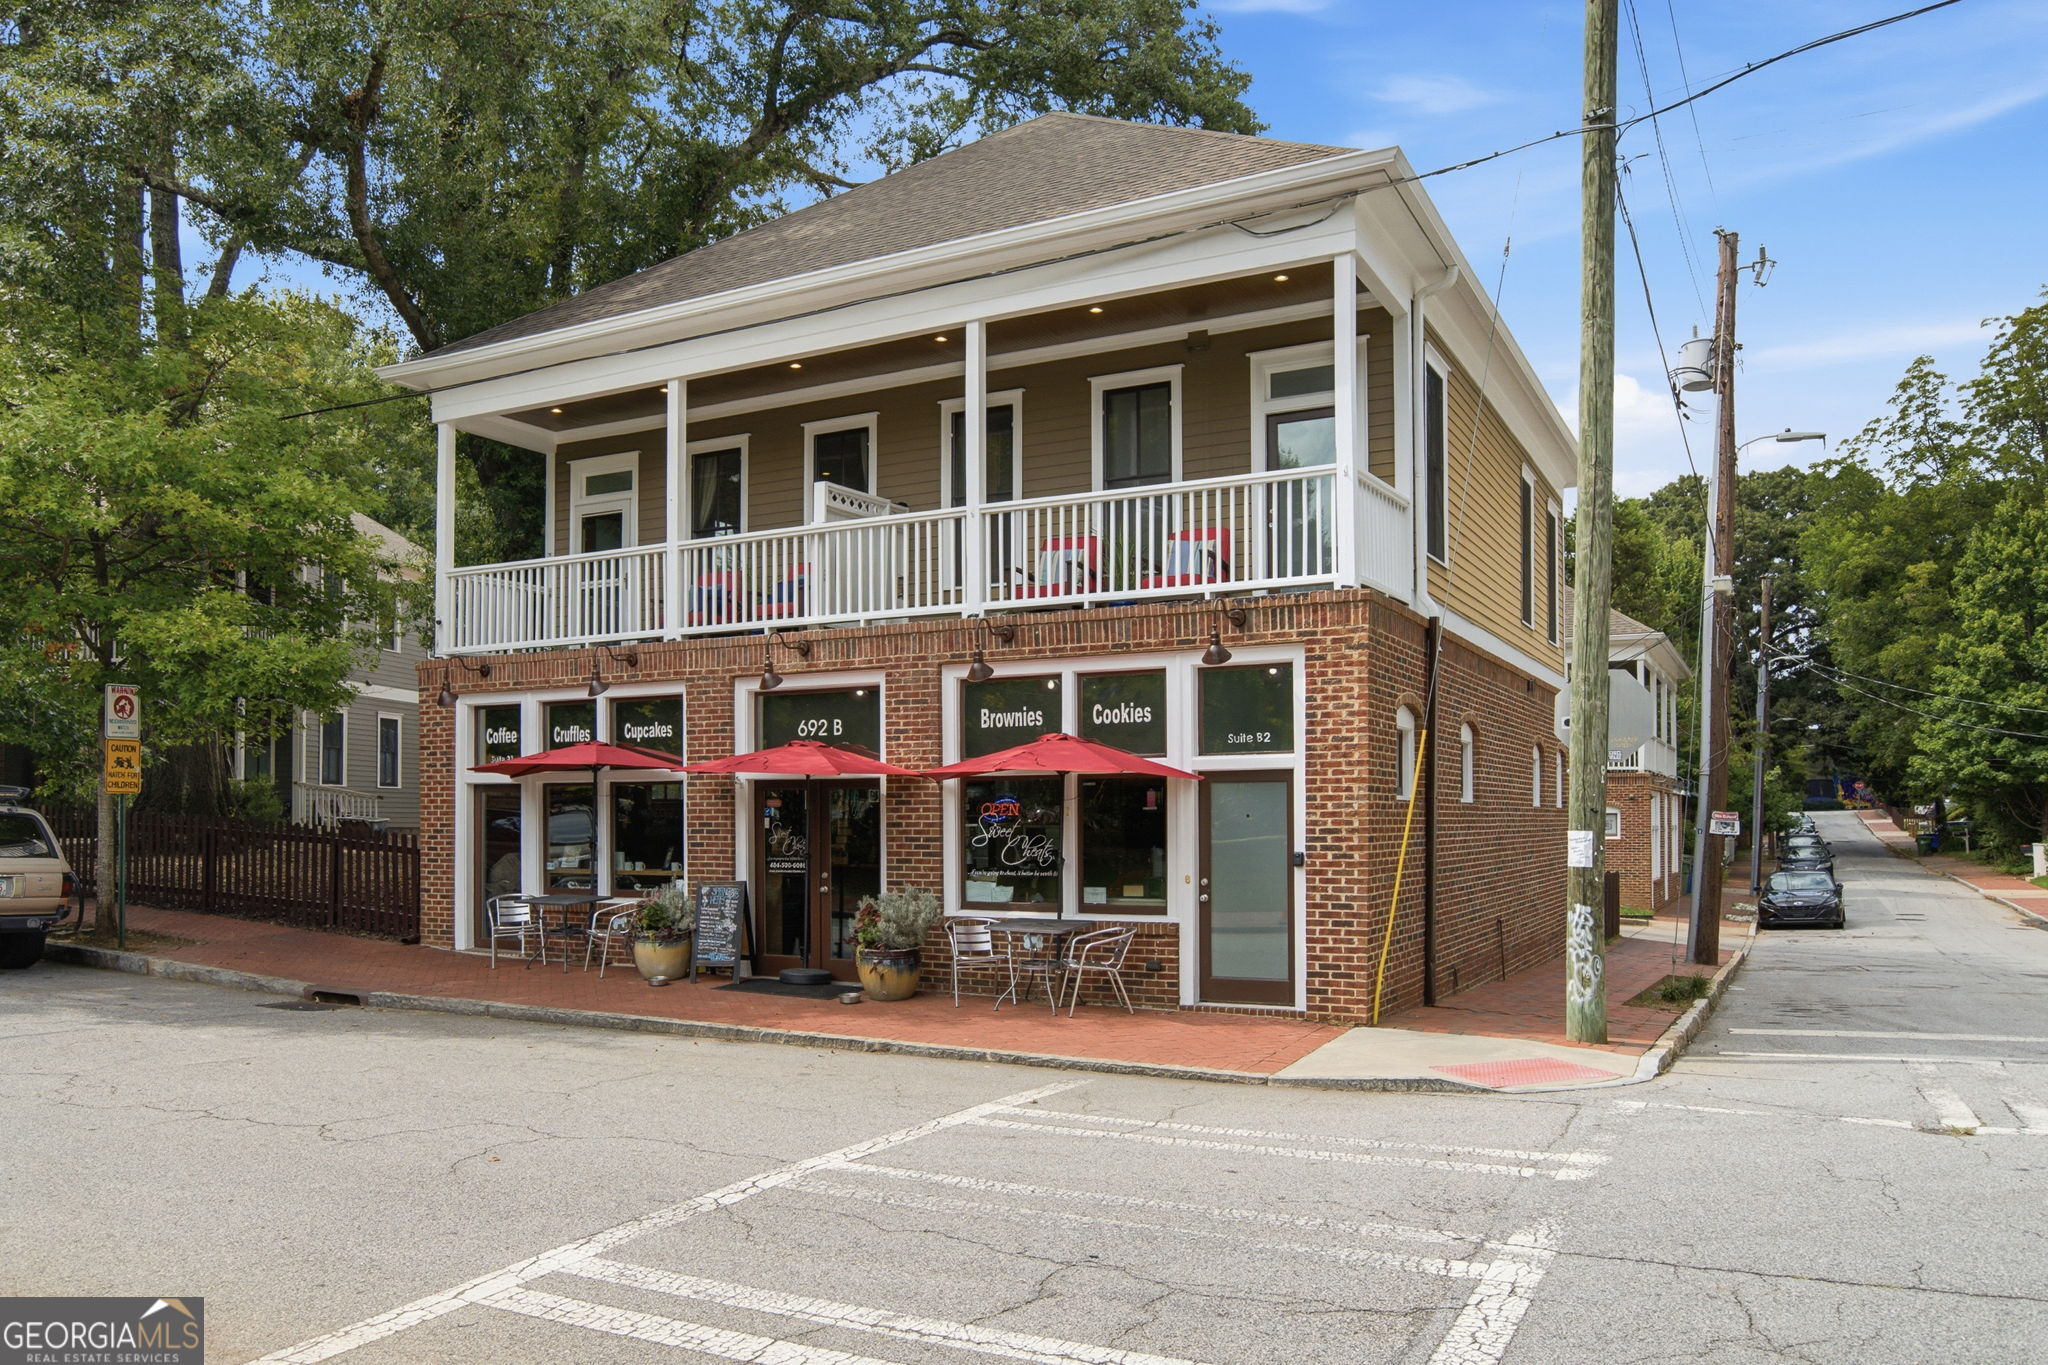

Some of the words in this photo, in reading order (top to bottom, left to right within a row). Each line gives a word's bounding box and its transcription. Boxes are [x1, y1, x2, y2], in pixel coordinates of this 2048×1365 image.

[980, 706, 1043, 729] Brownies
[1092, 703, 1152, 725] Cookies
[486, 727, 518, 744] Coffee
[553, 725, 591, 743] Cruffles
[624, 721, 673, 742] Cupcakes
[797, 719, 828, 737] 692
[833, 718, 843, 736] B
[1227, 732, 1254, 744] Suite
[110, 744, 137, 753] CAUTION
[108, 781, 138, 789] CHILDREN
[981, 803, 1020, 816] OPEN
[972, 813, 1022, 848] Sweet
[1001, 835, 1055, 867] Cheats
